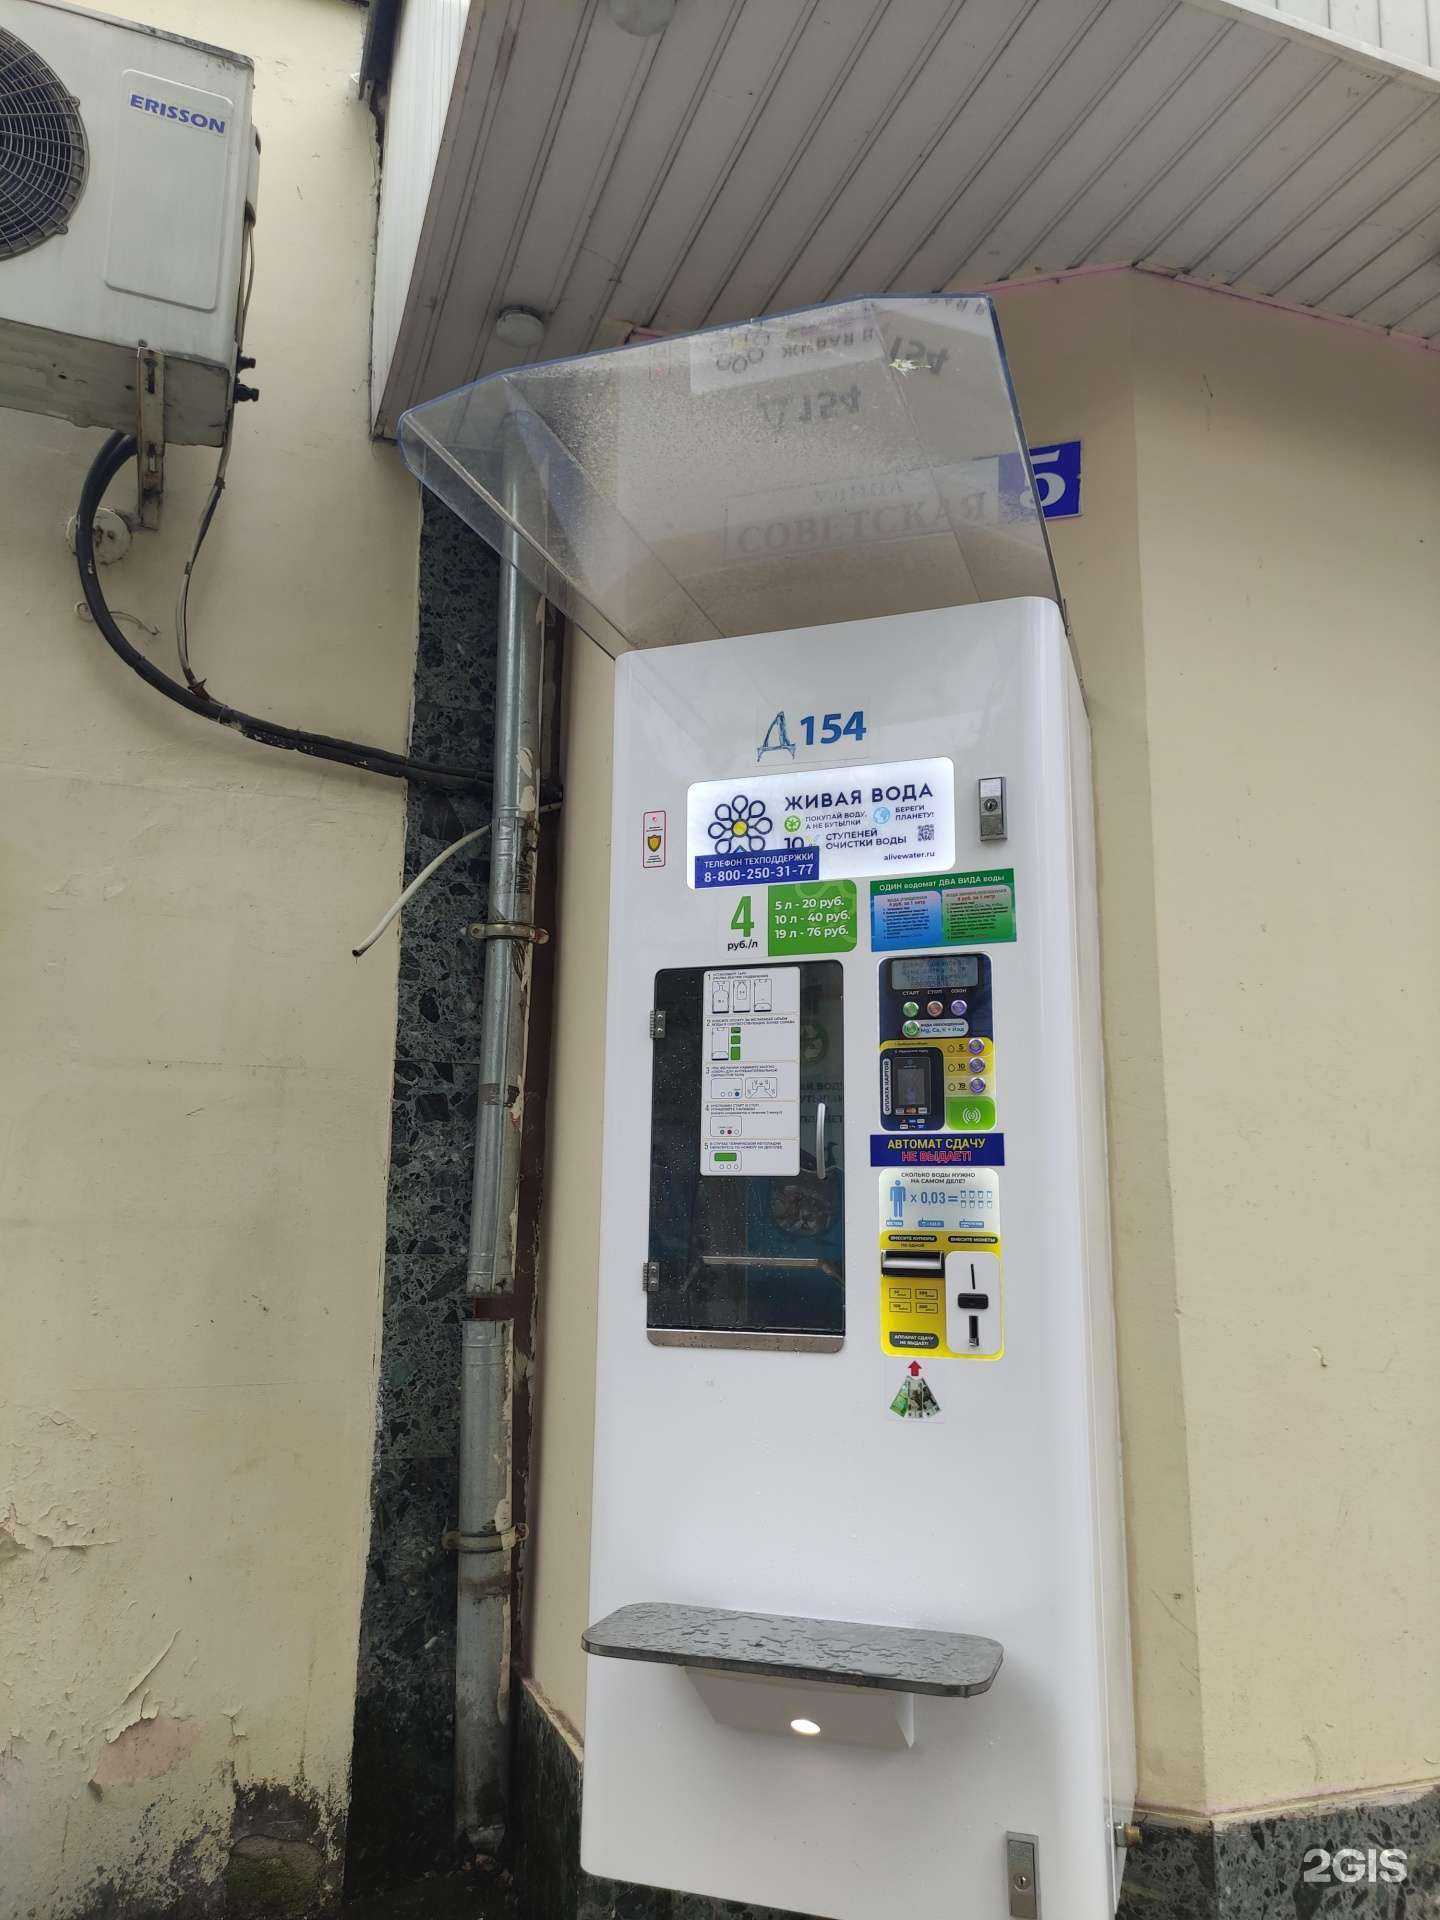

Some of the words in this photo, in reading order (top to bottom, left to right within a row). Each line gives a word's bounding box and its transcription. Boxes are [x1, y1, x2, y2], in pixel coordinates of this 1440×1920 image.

[130, 94, 226, 134] ERISSON
[1019, 449, 1066, 507] 5
[784, 790, 861, 811] ЖИВАЯ
[871, 783, 933, 803] ВОДА
[895, 805, 925, 813] БЕРЕГИ
[806, 813, 843, 822] ПОКУПАЙ
[895, 812, 934, 821] ПЛАНЕТУ!
[824, 820, 861, 829] БУТЫЛКИ
[826, 828, 877, 841] СТУПЕНЕЙ
[826, 839, 873, 849] ОЧИСТКИ
[875, 836, 907, 846] ВОДЫ
[704, 860, 742, 869] ТЕЛЕФОН
[744, 853, 814, 865] ТЕХПОДДЕРЖКИ
[883, 851, 935, 861] alivewater.ru
[704, 864, 814, 883] 8-800-250-31-77
[879, 882, 902, 891] ОДИН
[904, 881, 936, 889] водомат
[939, 878, 956, 888] ДВА
[958, 876, 981, 886] ВИДА
[983, 875, 1005, 883] воды
[775, 901, 782, 910] 5
[785, 902, 792, 910] л
[802, 898, 816, 908] 20
[820, 896, 844, 909] руб.
[730, 895, 754, 938] 4
[775, 915, 787, 924] 10
[808, 912, 823, 922] 40
[826, 910, 850, 923] руб.
[775, 929, 786, 939] 19
[789, 930, 797, 938] л
[807, 927, 821, 937] 76
[824, 925, 849, 939] руб.
[727, 939, 758, 951] руб./л
[888, 1139, 942, 1149] АВТОМАТ
[945, 1138, 986, 1151] СДАЧУ
[902, 1151, 918, 1162] НЕ
[920, 1191, 946, 1205] 0,03
